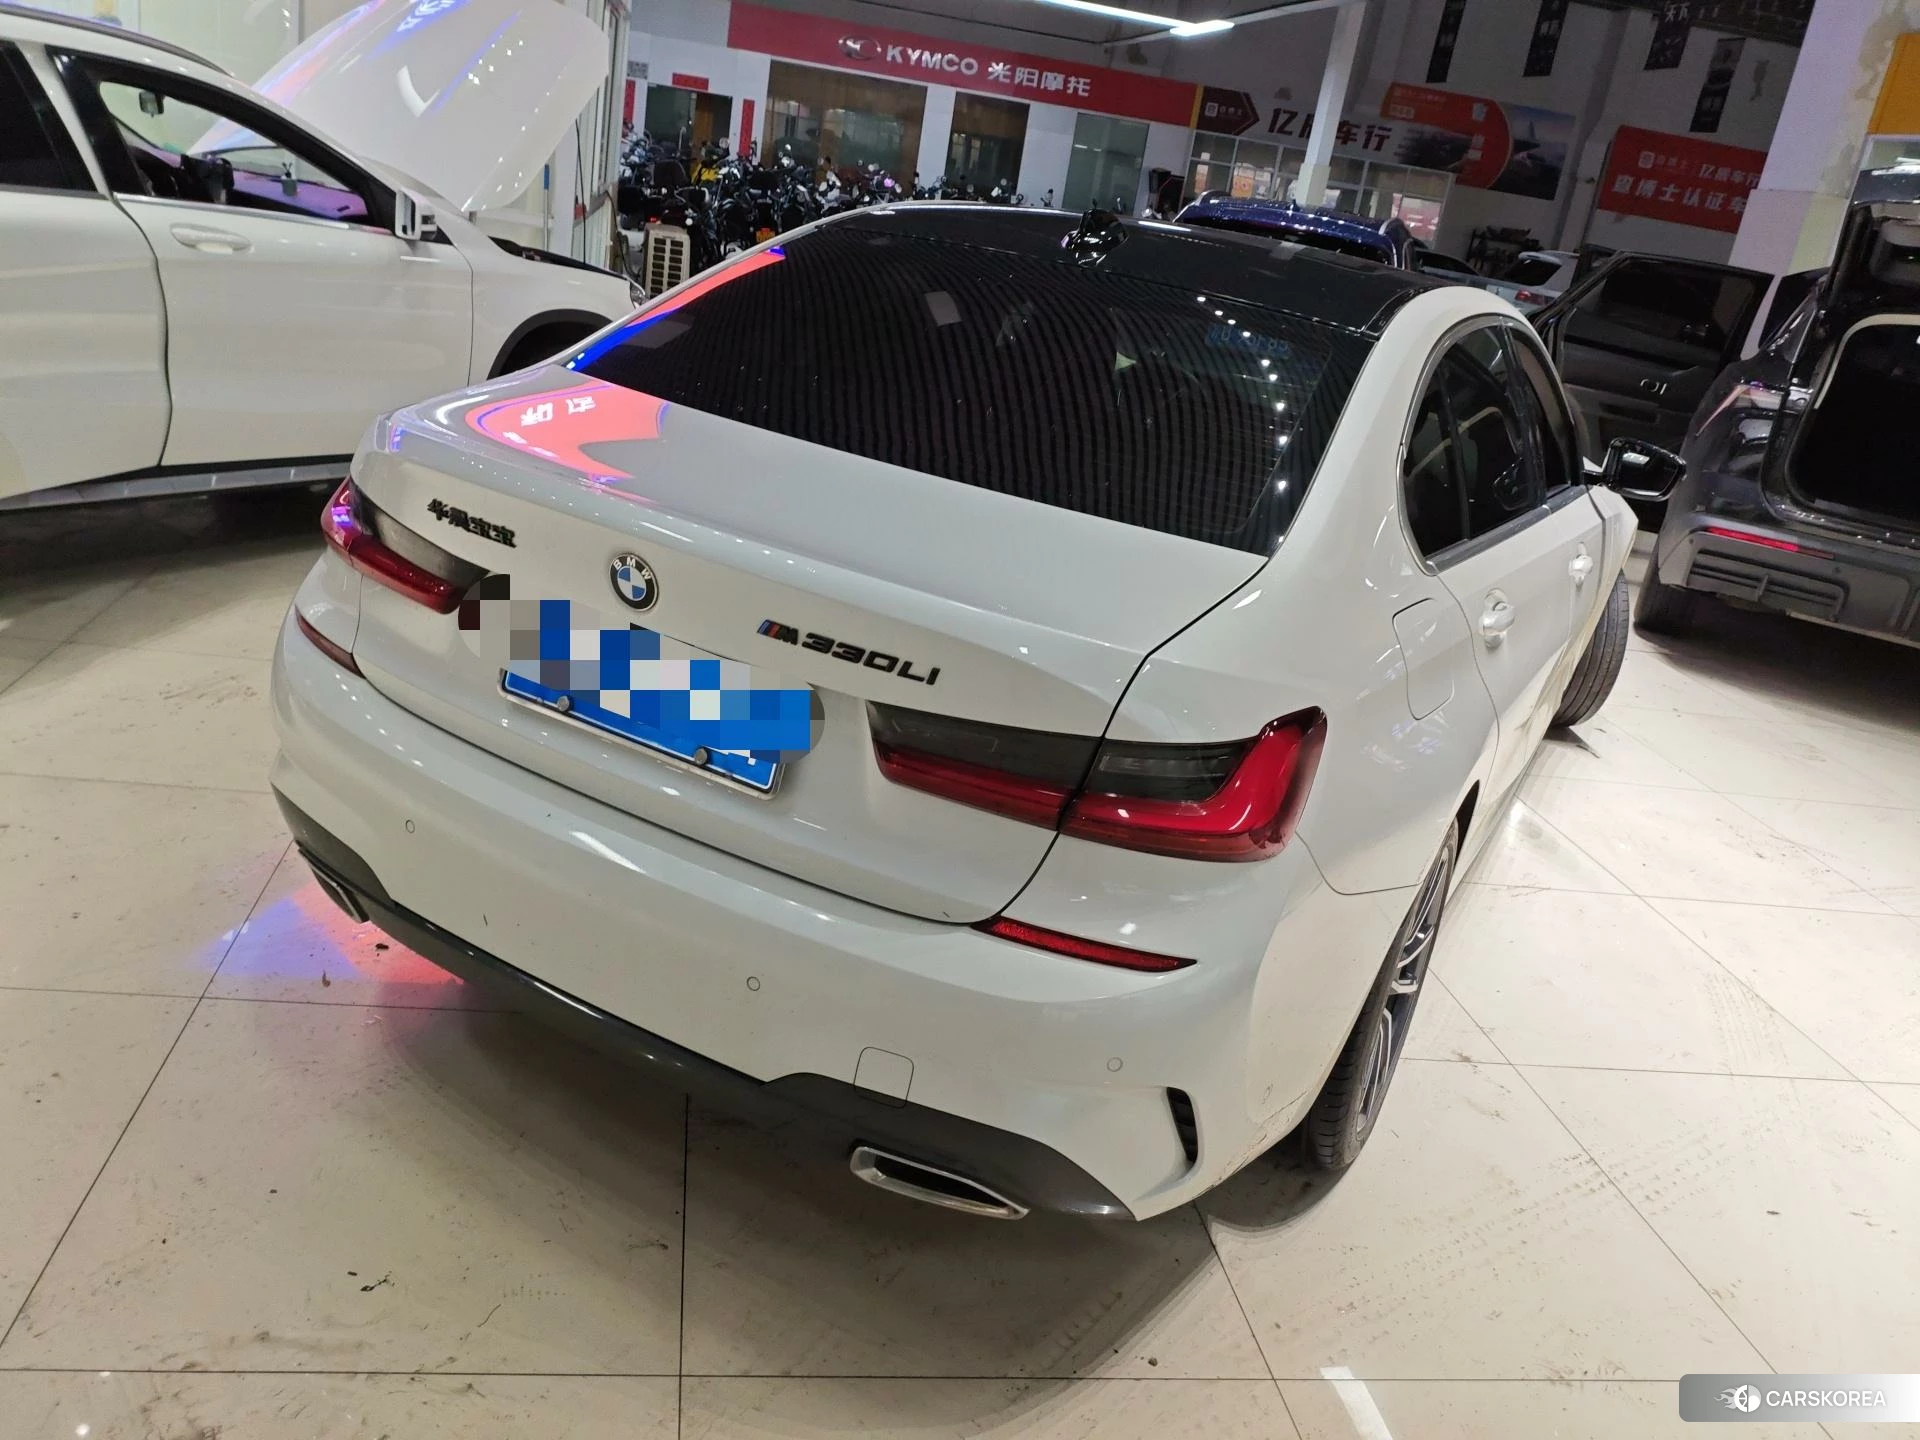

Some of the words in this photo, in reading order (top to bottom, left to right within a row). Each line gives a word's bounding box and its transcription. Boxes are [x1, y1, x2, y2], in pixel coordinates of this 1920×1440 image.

[886, 44, 979, 75] KYMCO
[987, 61, 1092, 97] 光阳摩托
[613, 556, 652, 580] BMW
